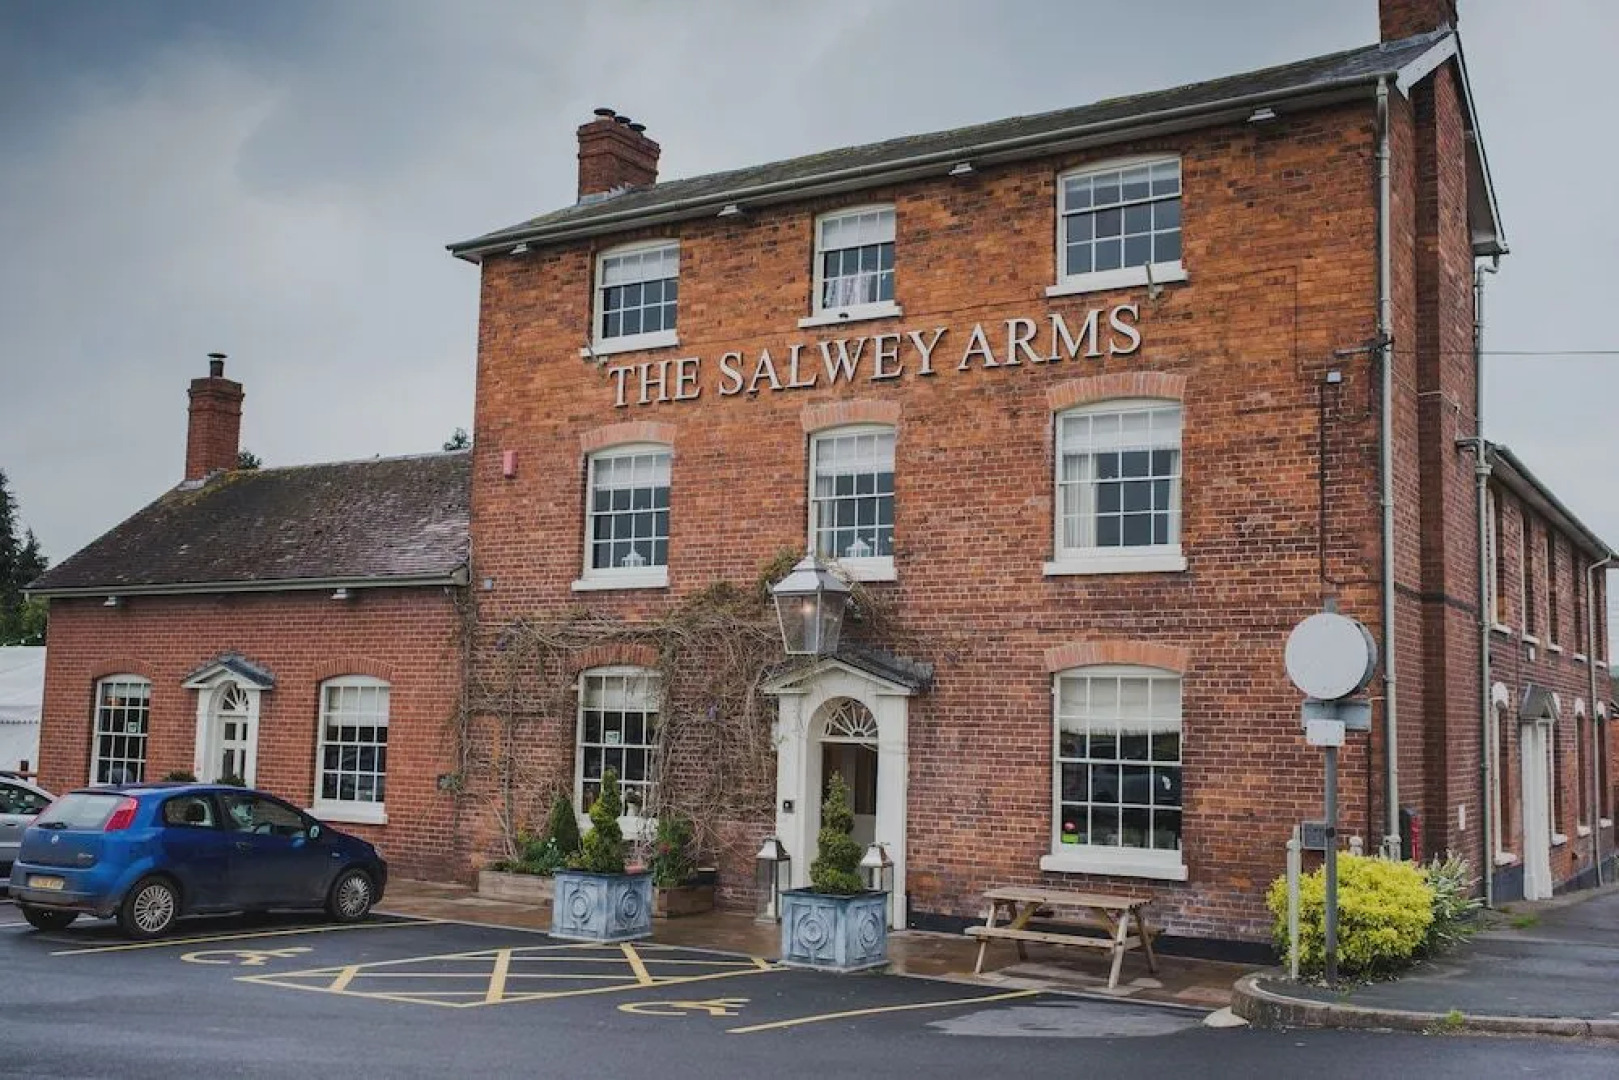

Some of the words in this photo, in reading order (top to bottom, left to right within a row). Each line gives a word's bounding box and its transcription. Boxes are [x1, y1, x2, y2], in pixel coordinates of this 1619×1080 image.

[608, 356, 702, 407] THE
[718, 327, 948, 396] SALWEY
[957, 303, 1142, 370] ARMS
